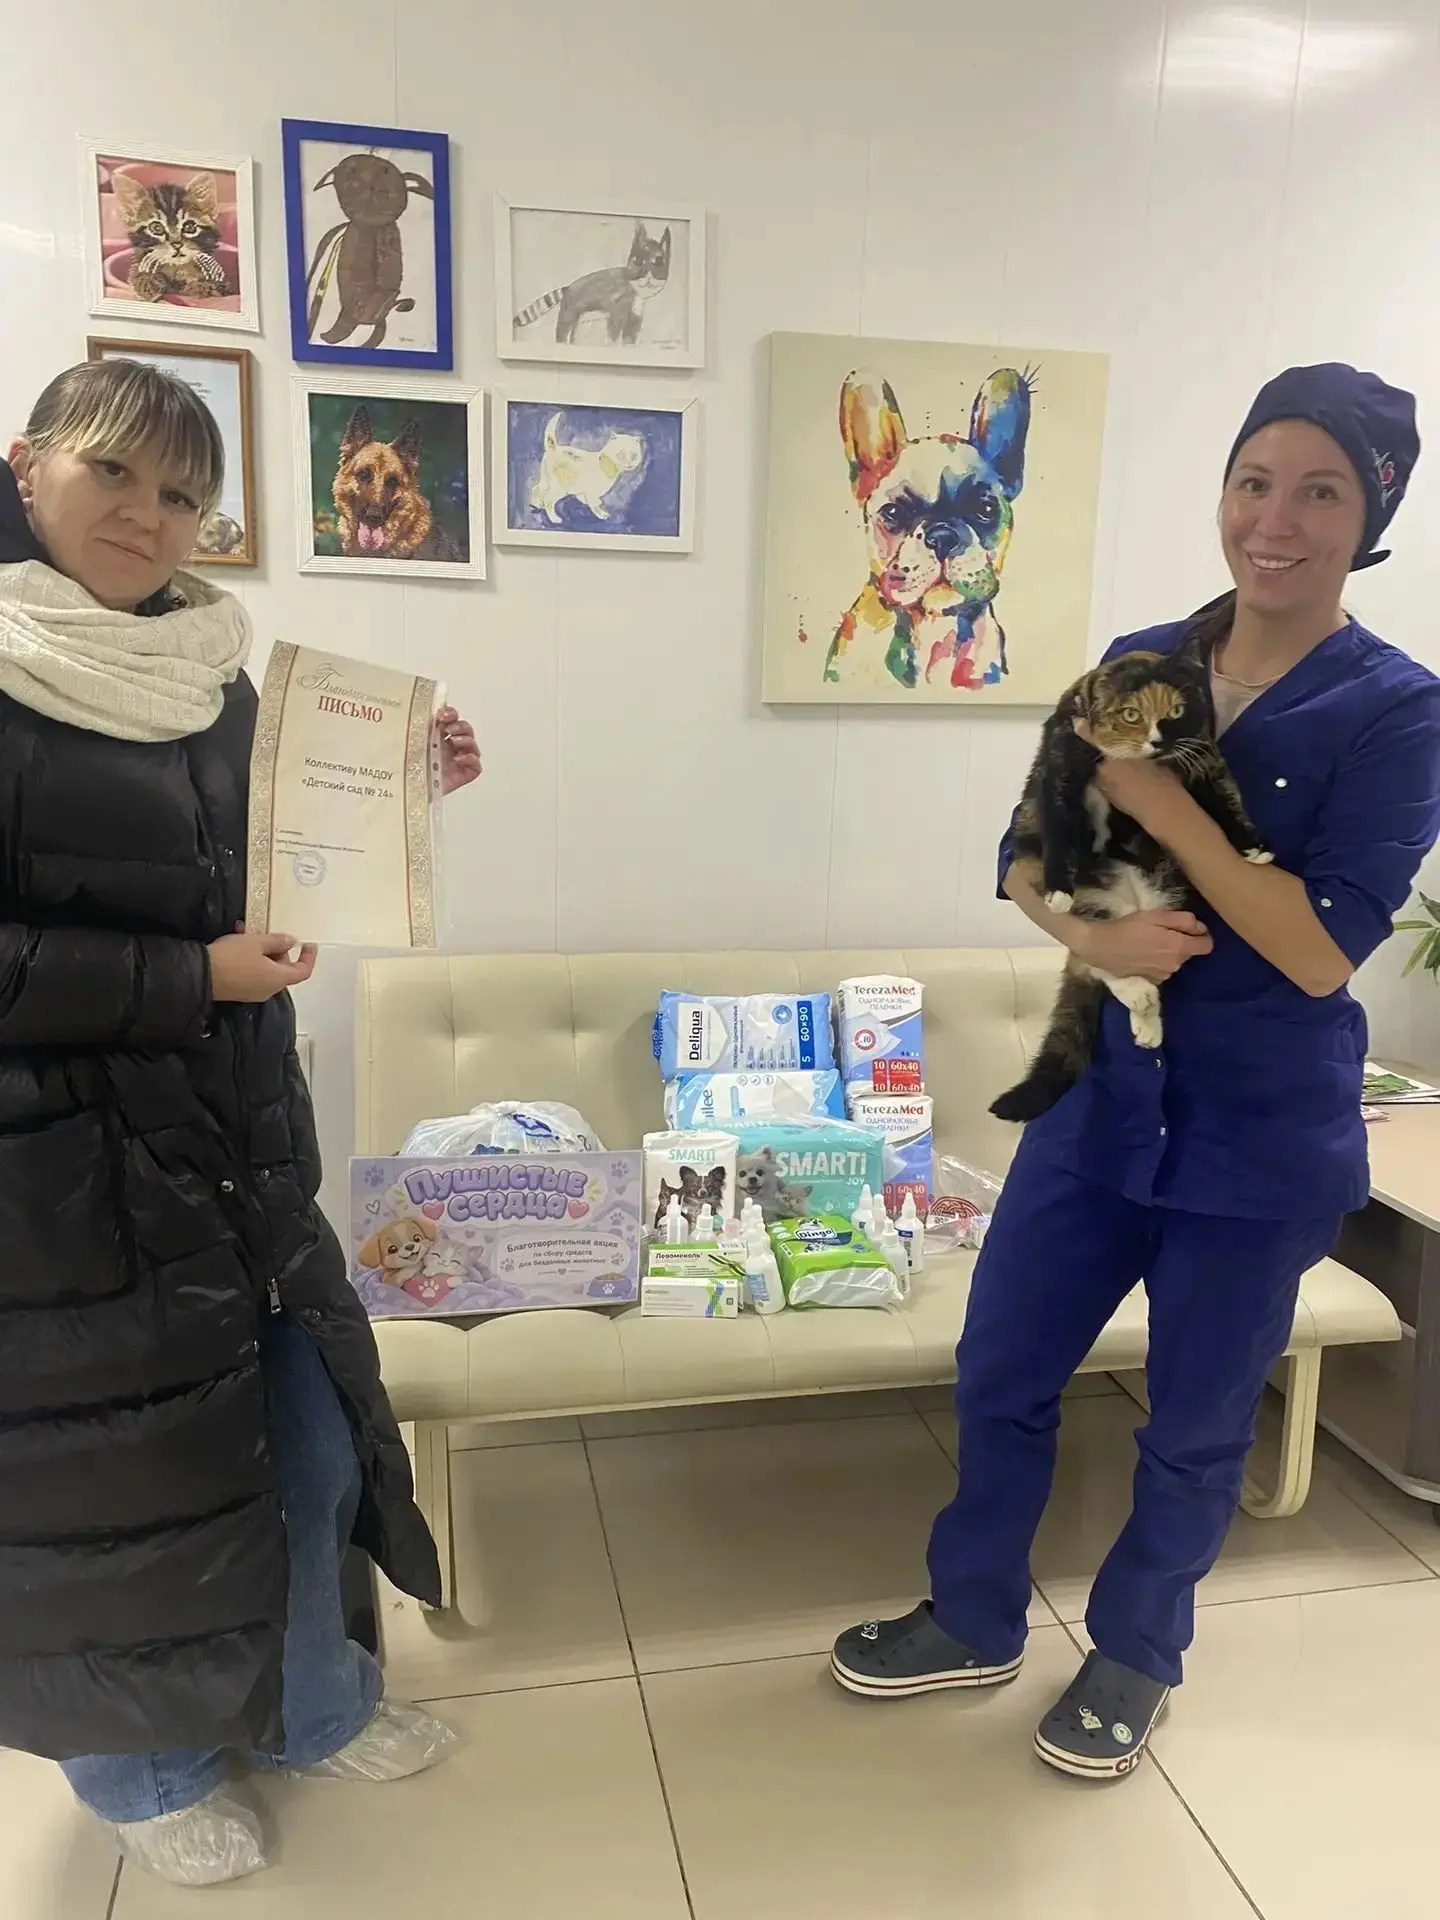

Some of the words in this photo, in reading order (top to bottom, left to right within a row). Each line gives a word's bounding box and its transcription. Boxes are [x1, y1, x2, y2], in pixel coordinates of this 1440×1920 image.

[318, 695, 383, 723] ПИСЬМО
[304, 757, 357, 776] Коллективу
[358, 767, 394, 780] МАДОУ
[301, 776, 345, 791] «Детский
[346, 785, 363, 796] сад
[364, 786, 376, 796] №
[377, 788, 394, 798] 24»
[689, 1010, 703, 1061] Deliqua
[801, 1055, 811, 1063] 5
[874, 1060, 885, 1070] 10
[861, 1104, 924, 1115] TerezaMed
[846, 1177, 865, 1185] JOY
[799, 1229, 833, 1239] Dingo
[506, 1239, 592, 1253] Благотворительная
[593, 1239, 619, 1248] акция
